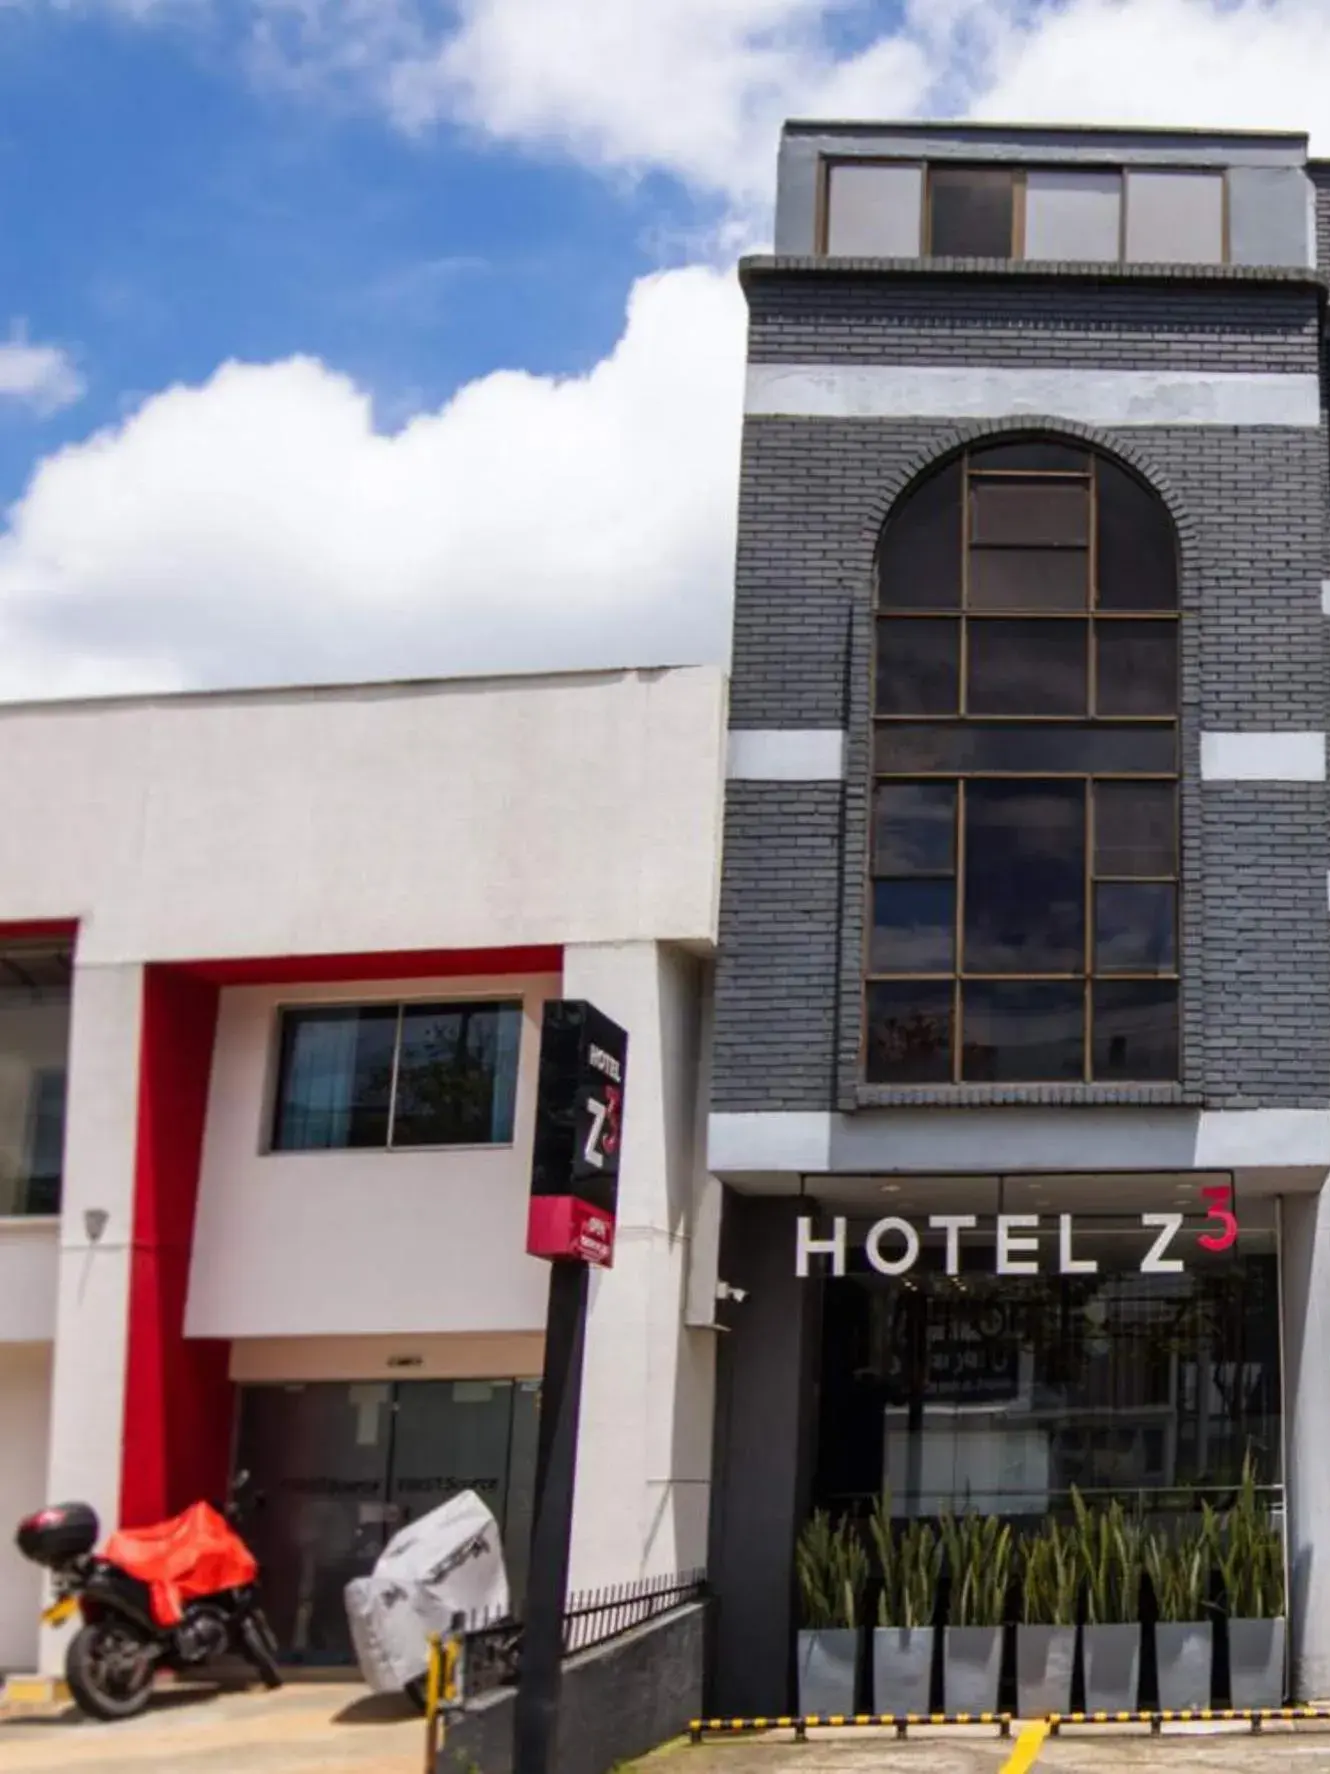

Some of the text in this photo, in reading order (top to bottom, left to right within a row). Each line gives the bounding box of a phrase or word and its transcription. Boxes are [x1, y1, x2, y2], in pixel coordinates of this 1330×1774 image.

[589, 1042, 621, 1083] HOTEL
[584, 1085, 620, 1168] Z3
[795, 1213, 1098, 1278] HOTEL
